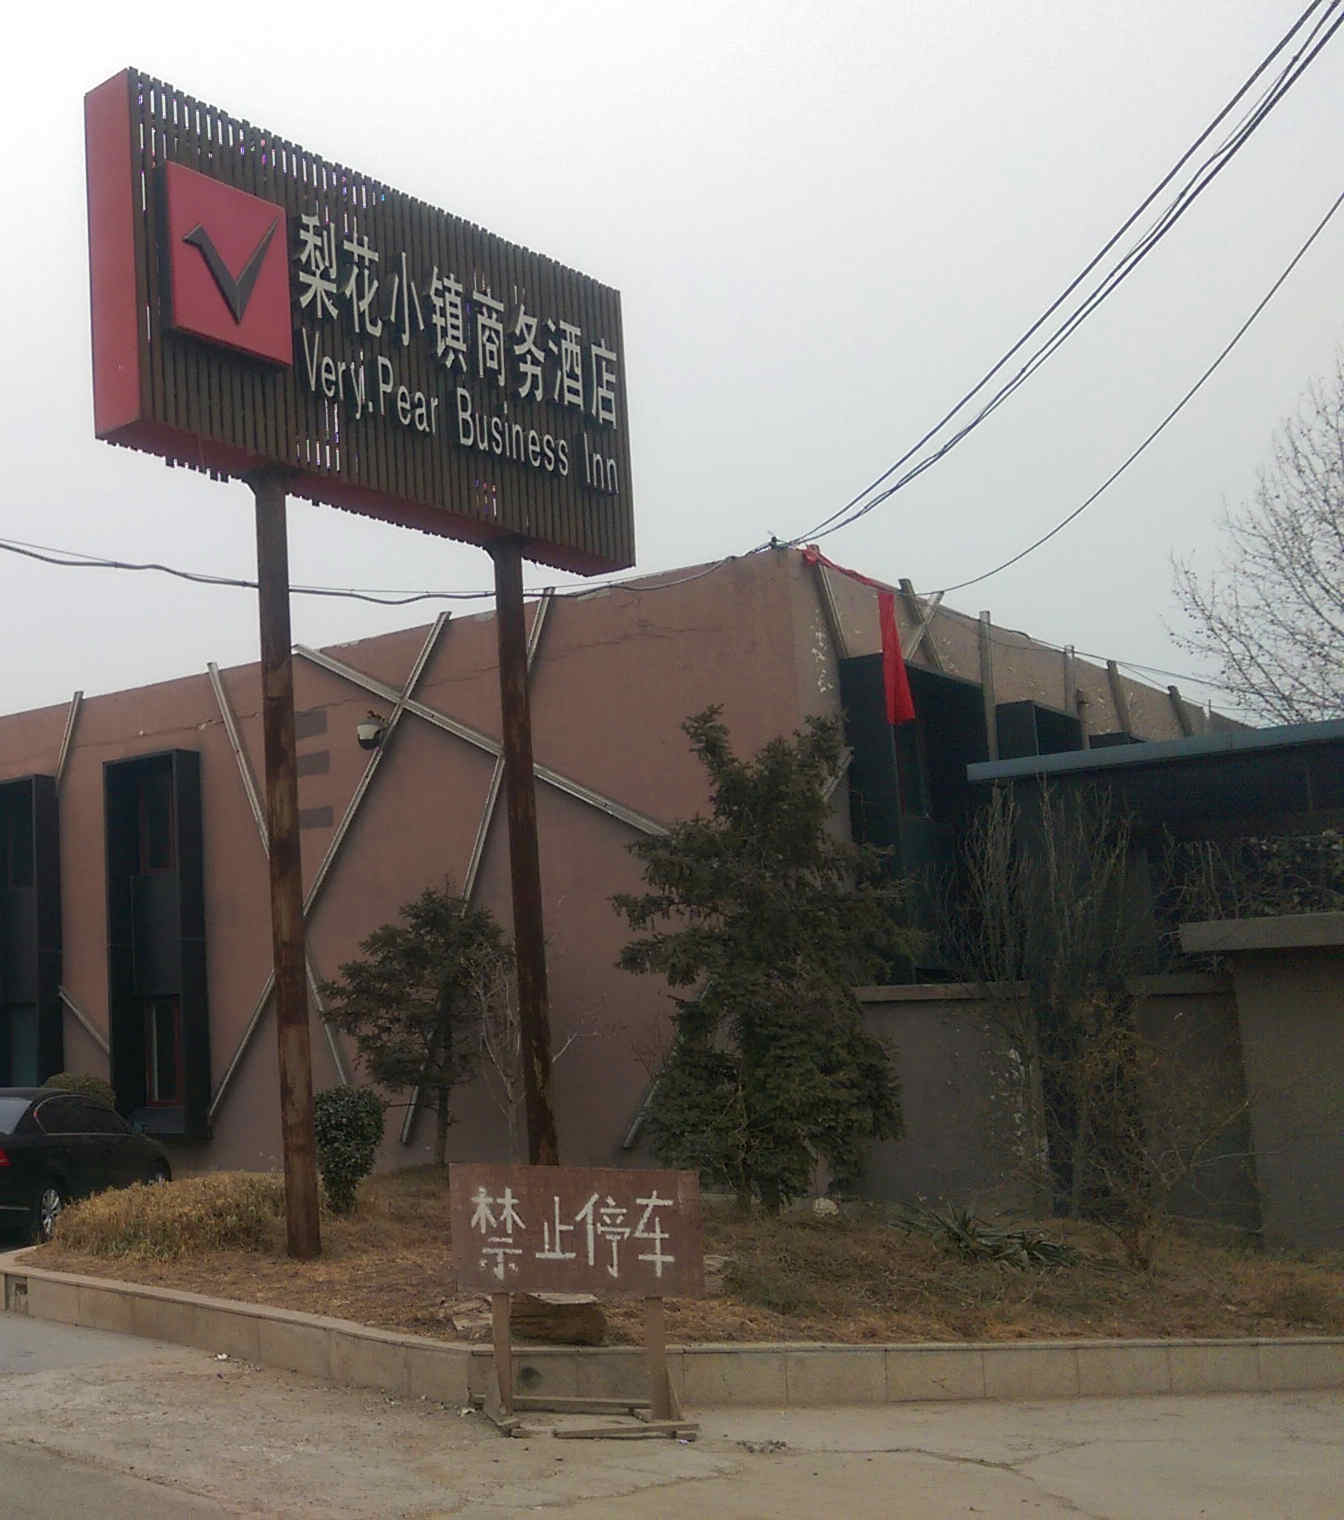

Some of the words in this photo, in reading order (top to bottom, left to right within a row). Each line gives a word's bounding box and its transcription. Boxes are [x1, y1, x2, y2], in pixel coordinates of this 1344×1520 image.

[298, 211, 618, 430] 梨花小镇商务酒店
[457, 386, 569, 476] Business
[584, 431, 620, 495] Inn
[470, 1186, 676, 1280] 禁止停车
